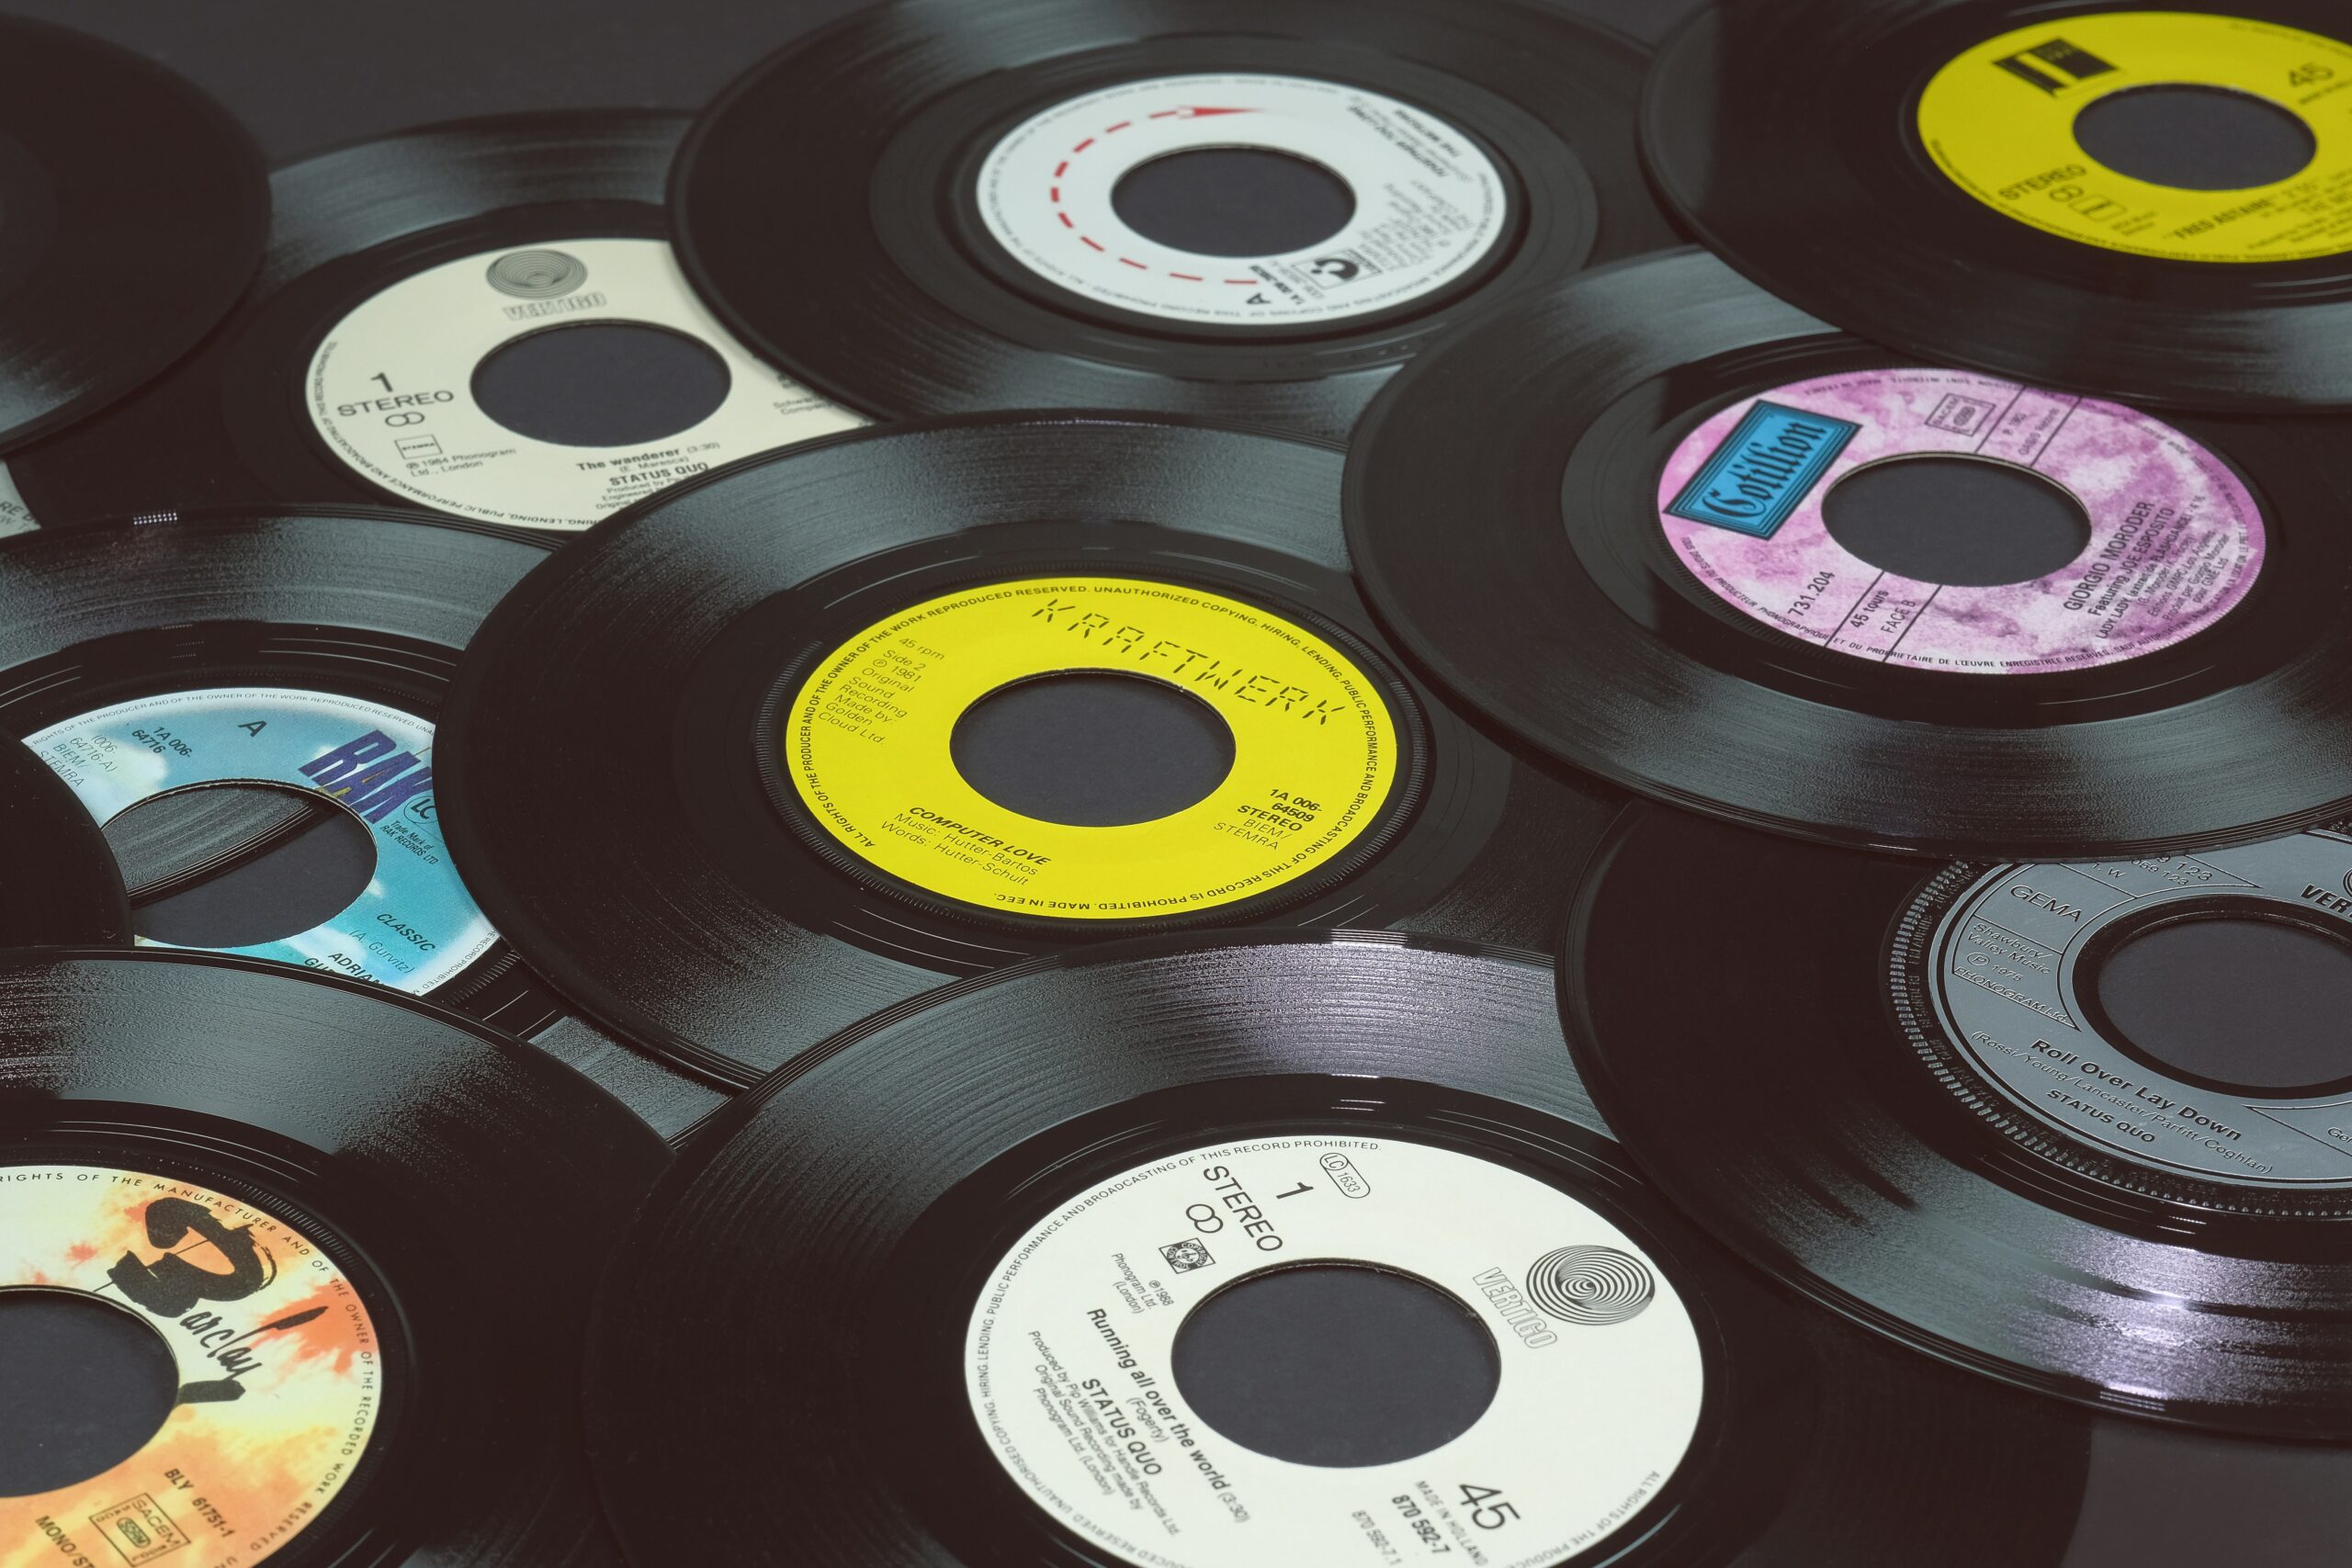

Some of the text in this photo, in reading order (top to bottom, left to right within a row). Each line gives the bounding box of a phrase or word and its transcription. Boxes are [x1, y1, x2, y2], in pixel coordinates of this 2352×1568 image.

[2287, 63, 2335, 88] 45
[1999, 164, 2087, 201] STEREO
[503, 292, 608, 321] VERTIGO
[1246, 292, 1272, 305] A
[371, 372, 393, 392] 1
[338, 389, 454, 417] STEREO
[423, 448, 516, 467] 1984 Phonogram
[441, 461, 483, 474] London
[575, 442, 720, 472] The wanderer (3:30)
[609, 461, 709, 487] STATUS QUO
[1702, 421, 1826, 518] Cotillion
[606, 481, 650, 494] Produced
[2064, 502, 2154, 610] GIORGIO MORODER
[2087, 508, 2175, 615] Featuring JOE ESPOSITO
[1788, 571, 1835, 615] 731.204
[1850, 591, 1889, 627] 45 tours
[2096, 618, 2117, 638] LADY
[2110, 598, 2133, 618] LADY
[2127, 573, 2148, 596] (extrait
[2147, 592, 2173, 617] Editions
[1881, 607, 1910, 633] FACE
[883, 650, 926, 671] Side 2
[899, 638, 944, 660] 45 rpm
[1032, 588, 1345, 725] KRAFTWERK
[849, 677, 895, 698] Sound
[862, 668, 914, 692] Original
[892, 666, 922, 682] 1981
[311, 698, 370, 712] REPRODUCED
[826, 703, 872, 726] Golden
[835, 694, 867, 711] Made
[840, 684, 907, 717] Recording
[238, 721, 267, 737] A
[819, 712, 859, 732] Cloud
[53, 744, 87, 767] BIEM/
[61, 738, 118, 772] 64716-A)
[91, 733, 117, 751] (006-
[132, 730, 165, 753] 64716
[154, 728, 192, 757] 1A 006-
[800, 586, 1377, 909] ALL RIGHTS PRODUCER AND OWNER THE WORK REPRODUCED RESERVED. UNAUTHORIZED PUBLIC PERFORMANCE AND BROADCASTING THIS RECORD PROHIBITED. MADE
[30, 752, 84, 785] STEMRA
[298, 729, 434, 823] RAK
[1271, 789, 1322, 811] 1A 006-
[1272, 803, 1315, 822] 64509
[386, 820, 425, 845] Trade Mark
[1238, 806, 1302, 830] STEREO
[1243, 819, 1292, 839] BIEM/
[380, 826, 426, 856] RAK RECORDS
[894, 813, 1037, 874] Music: Hutter-Bartos
[910, 807, 1051, 864] COMPUTER LOVE
[1214, 823, 1278, 850] STEMRA
[882, 821, 1028, 885] Words: Hutter-Schult
[2163, 873, 2188, 886] 123
[2177, 863, 2212, 881] 123
[2011, 886, 2081, 922] GEMA
[377, 914, 435, 951] CLASSIC
[1973, 922, 2053, 959] Shawbury/
[368, 937, 422, 973] Gurvitz)
[1967, 931, 2051, 974] Valley Music
[1955, 965, 2046, 1010] PHONOGRAM
[1972, 1031, 2273, 1174] (Rossi/Young/Lancaster/Parfitt/Coghlan)
[2031, 1041, 2242, 1141] Roll Over Lay Down
[2047, 1090, 2155, 1142] STATUS QUO
[1276, 1182, 1314, 1199] 1
[1324, 1156, 1360, 1191] LC 1633
[1204, 1166, 1283, 1251] STEREO
[987, 1142, 1290, 1314] PUBLIC PERFORMANCE BROADCASTING RECORD
[1112, 1253, 1146, 1293] Phonogram
[1141, 1294, 1158, 1307] Ltd.
[106, 1197, 328, 1405] Barclay
[1113, 1281, 1145, 1314] (London)
[1473, 1267, 1557, 1348] VERTIGO
[153, 1184, 371, 1550] MANUFACTURER AND OWNER RECORDED WORK RESERVED
[1029, 1331, 1167, 1518] Produced Williams Handle Records
[1035, 1365, 1134, 1497] Original Sound Recording made
[1082, 1379, 1161, 1474] STATUS QUO
[1087, 1309, 1249, 1522] Running all over the world (3:30)
[1126, 1398, 1169, 1442] (Fogerty)
[1034, 1388, 1114, 1495] Phonogram (London)
[164, 1468, 194, 1489] BLY
[193, 1497, 235, 1537] 61751-1
[1459, 1484, 1521, 1529] 45
[123, 1499, 189, 1549] SACEM
[1392, 1495, 1450, 1552] 870 592-7
[1450, 1521, 1487, 1564] HOLLAND
